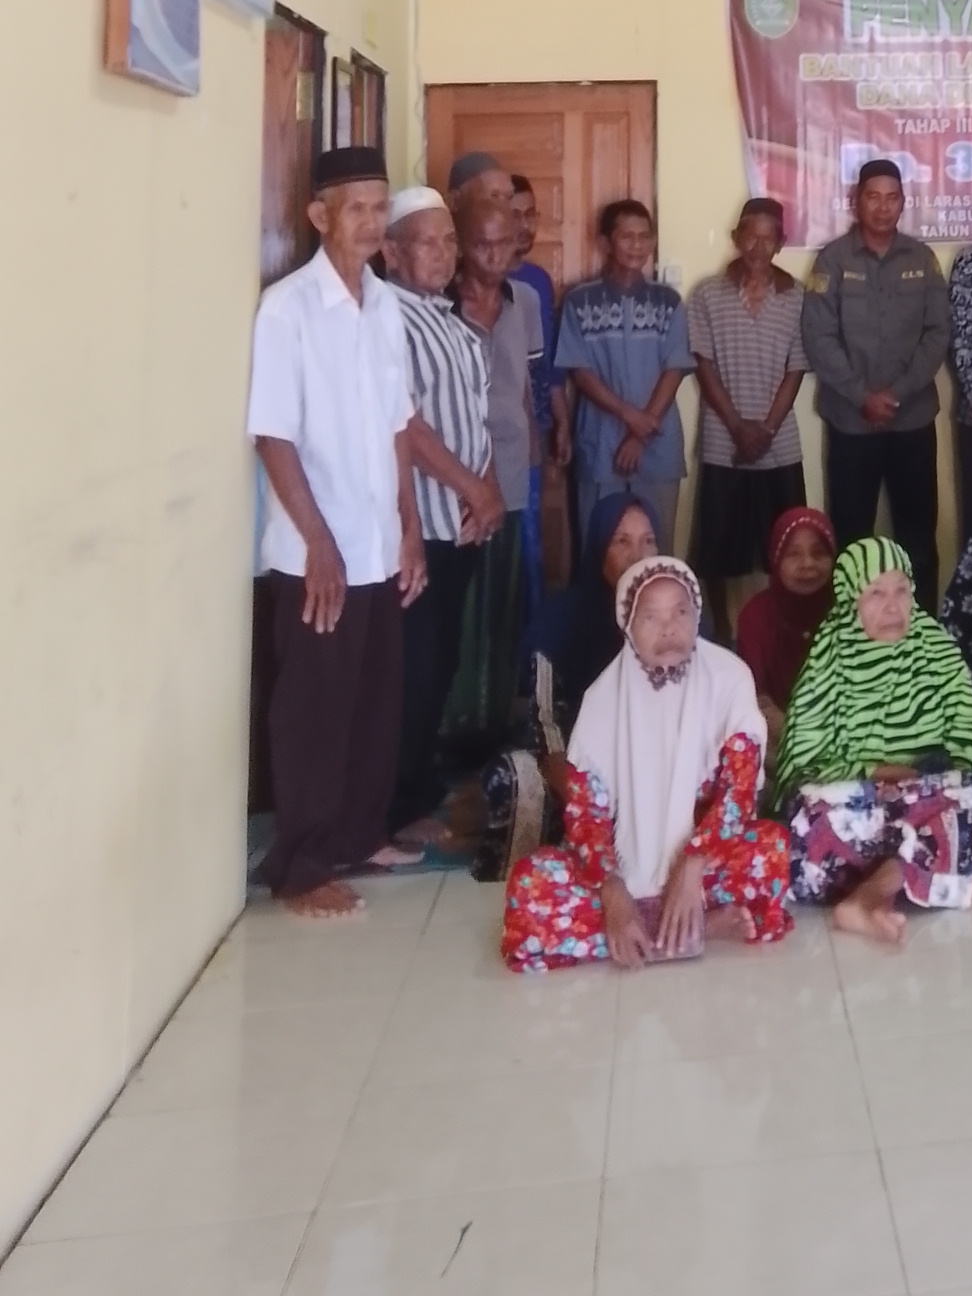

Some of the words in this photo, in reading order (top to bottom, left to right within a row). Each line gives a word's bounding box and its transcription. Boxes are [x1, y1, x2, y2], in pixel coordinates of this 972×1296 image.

[801, 52, 942, 80] BANTUAN
[894, 118, 950, 134] TAHAP
[956, 117, 972, 133] III
[924, 194, 971, 207] LARAS
[920, 224, 969, 237] TAHUN
